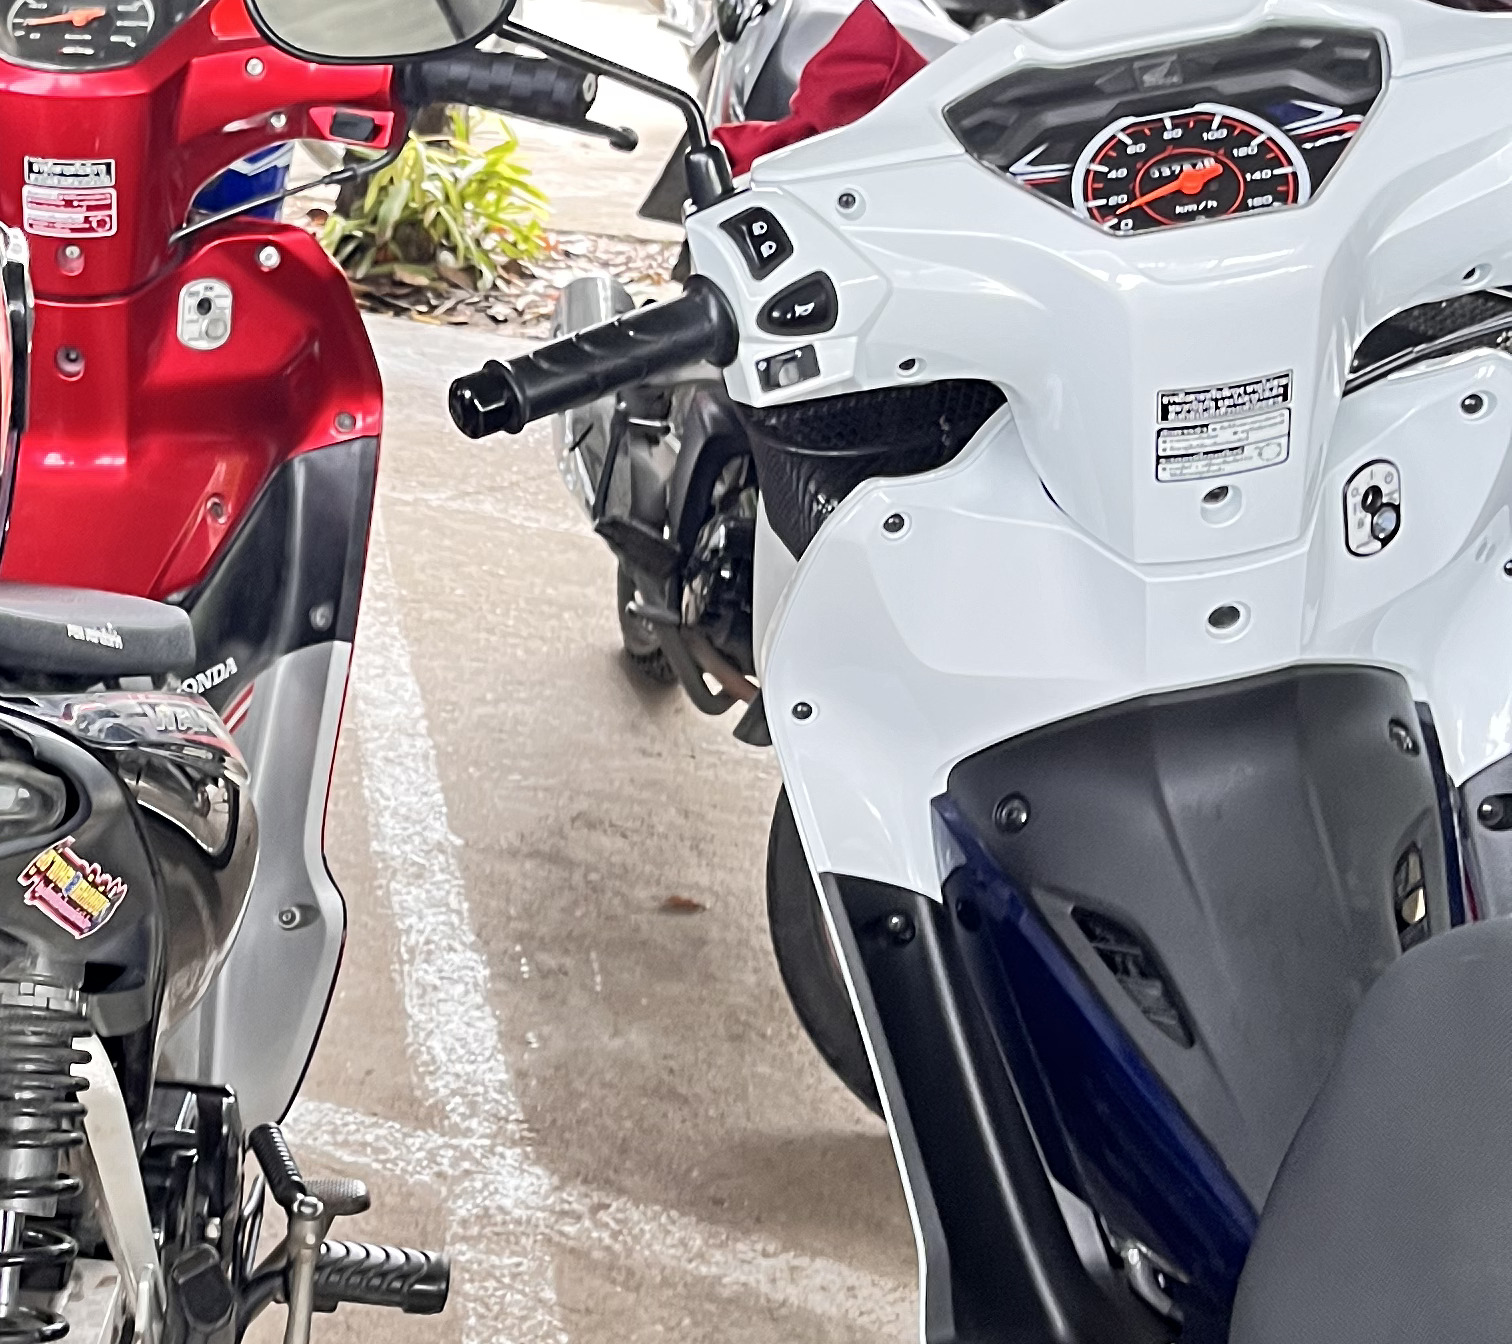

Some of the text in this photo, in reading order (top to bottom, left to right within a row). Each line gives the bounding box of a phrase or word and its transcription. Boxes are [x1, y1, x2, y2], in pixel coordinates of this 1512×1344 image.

[1202, 128, 1228, 141] 100
[1107, 167, 1128, 180] 40
[1245, 169, 1272, 183] 140
[1175, 199, 1218, 215] km/h
[177, 657, 237, 693] ONDA
